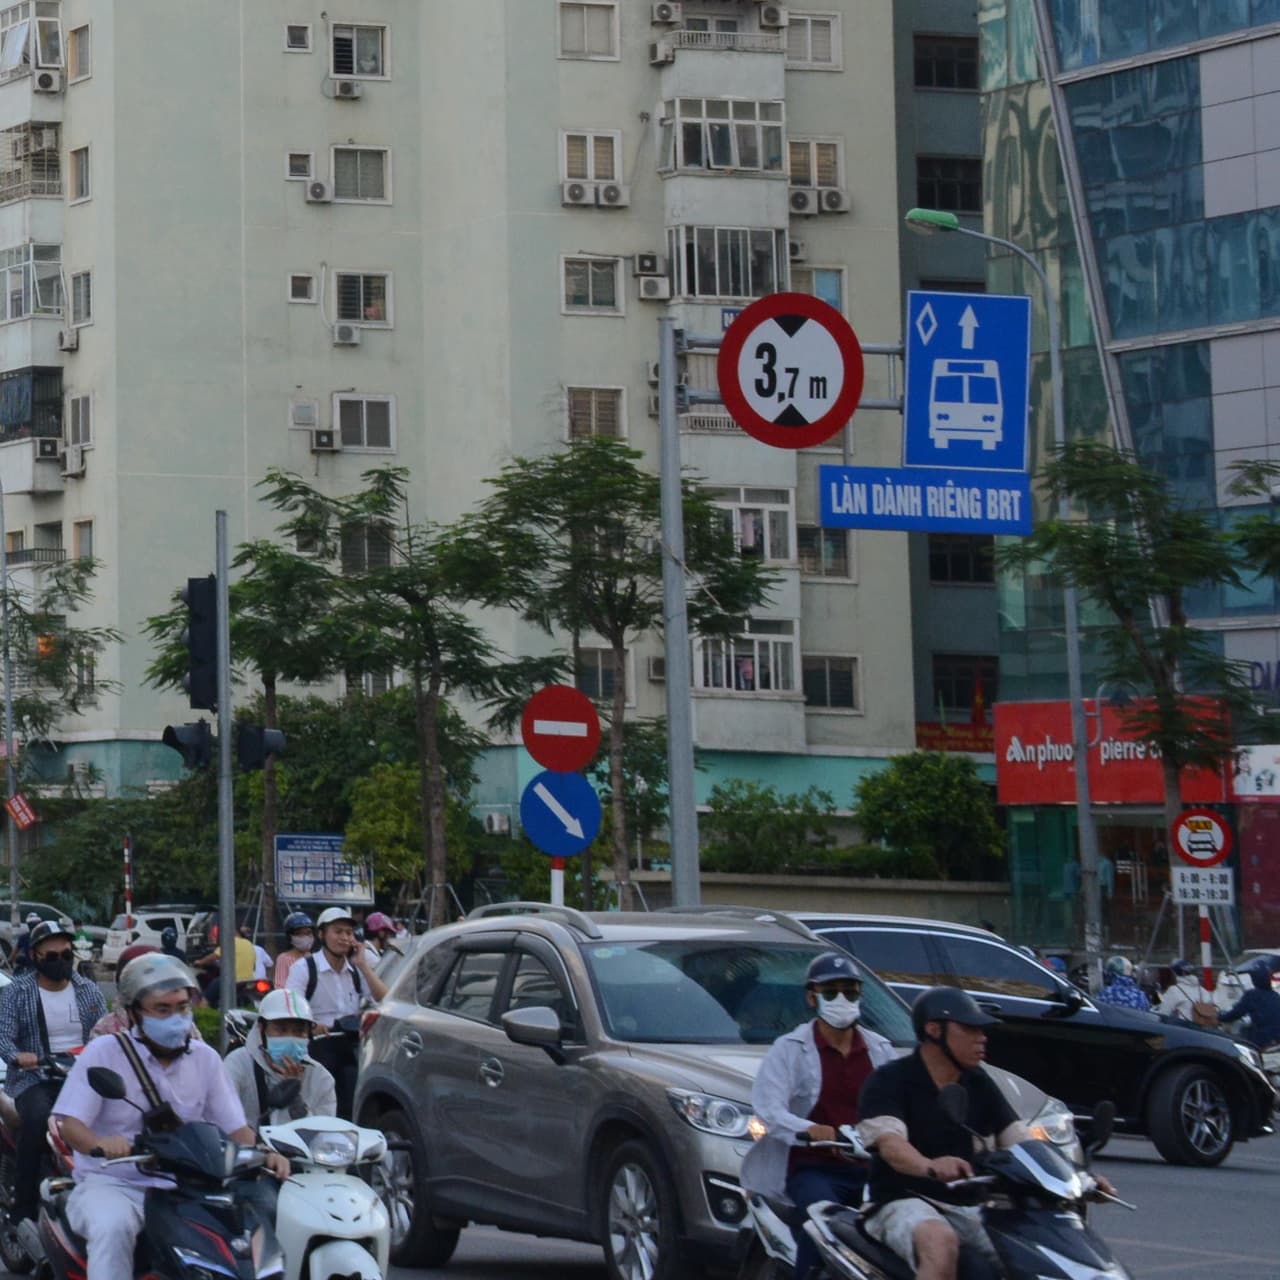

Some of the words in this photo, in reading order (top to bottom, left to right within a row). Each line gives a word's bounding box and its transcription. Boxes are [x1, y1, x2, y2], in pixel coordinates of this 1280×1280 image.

[755, 342, 800, 404] 3,7
[810, 376, 829, 401] m
[831, 475, 868, 516] LÀN
[872, 477, 924, 518] DÀNH
[927, 479, 984, 521] RIÊNG
[987, 488, 1024, 522] BRT
[1100, 736, 1146, 767] pierre
